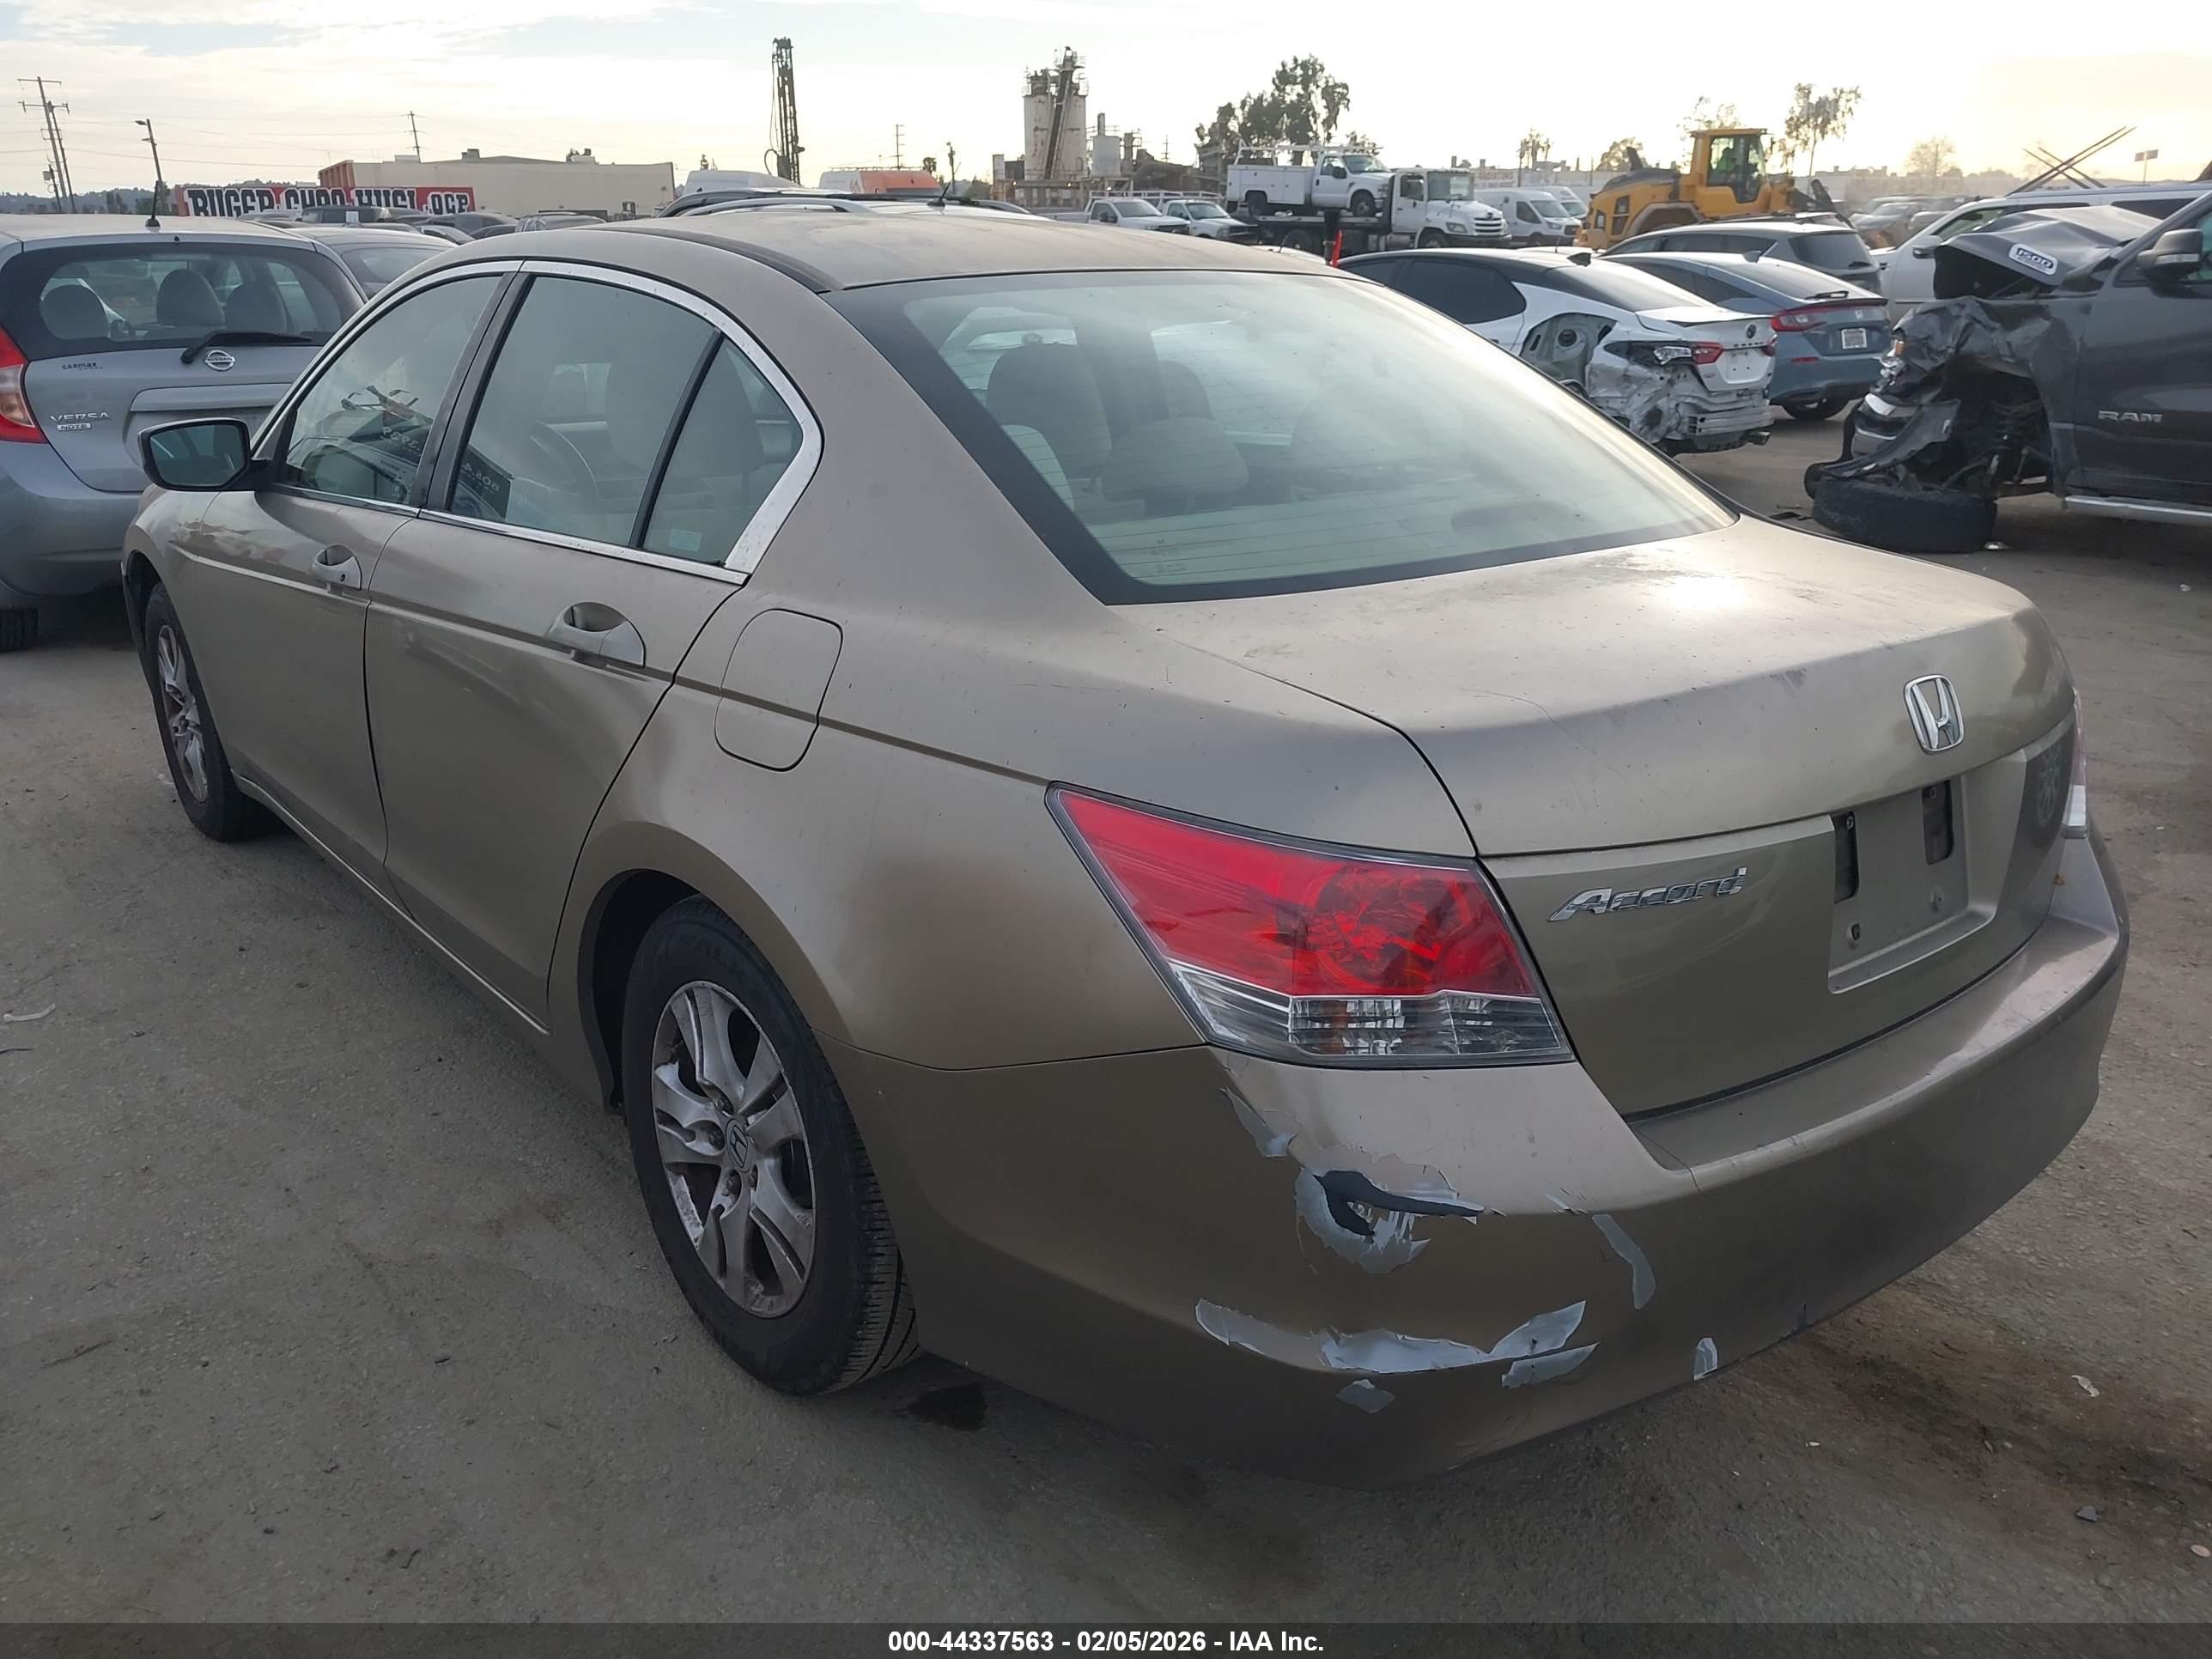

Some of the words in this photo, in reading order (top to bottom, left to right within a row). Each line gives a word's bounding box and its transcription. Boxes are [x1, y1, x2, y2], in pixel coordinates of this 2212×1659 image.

[2017, 248, 2053, 268] 1500
[50, 412, 110, 422] VERSA
[2098, 410, 2163, 423] RAM
[1547, 866, 1747, 921] Accord
